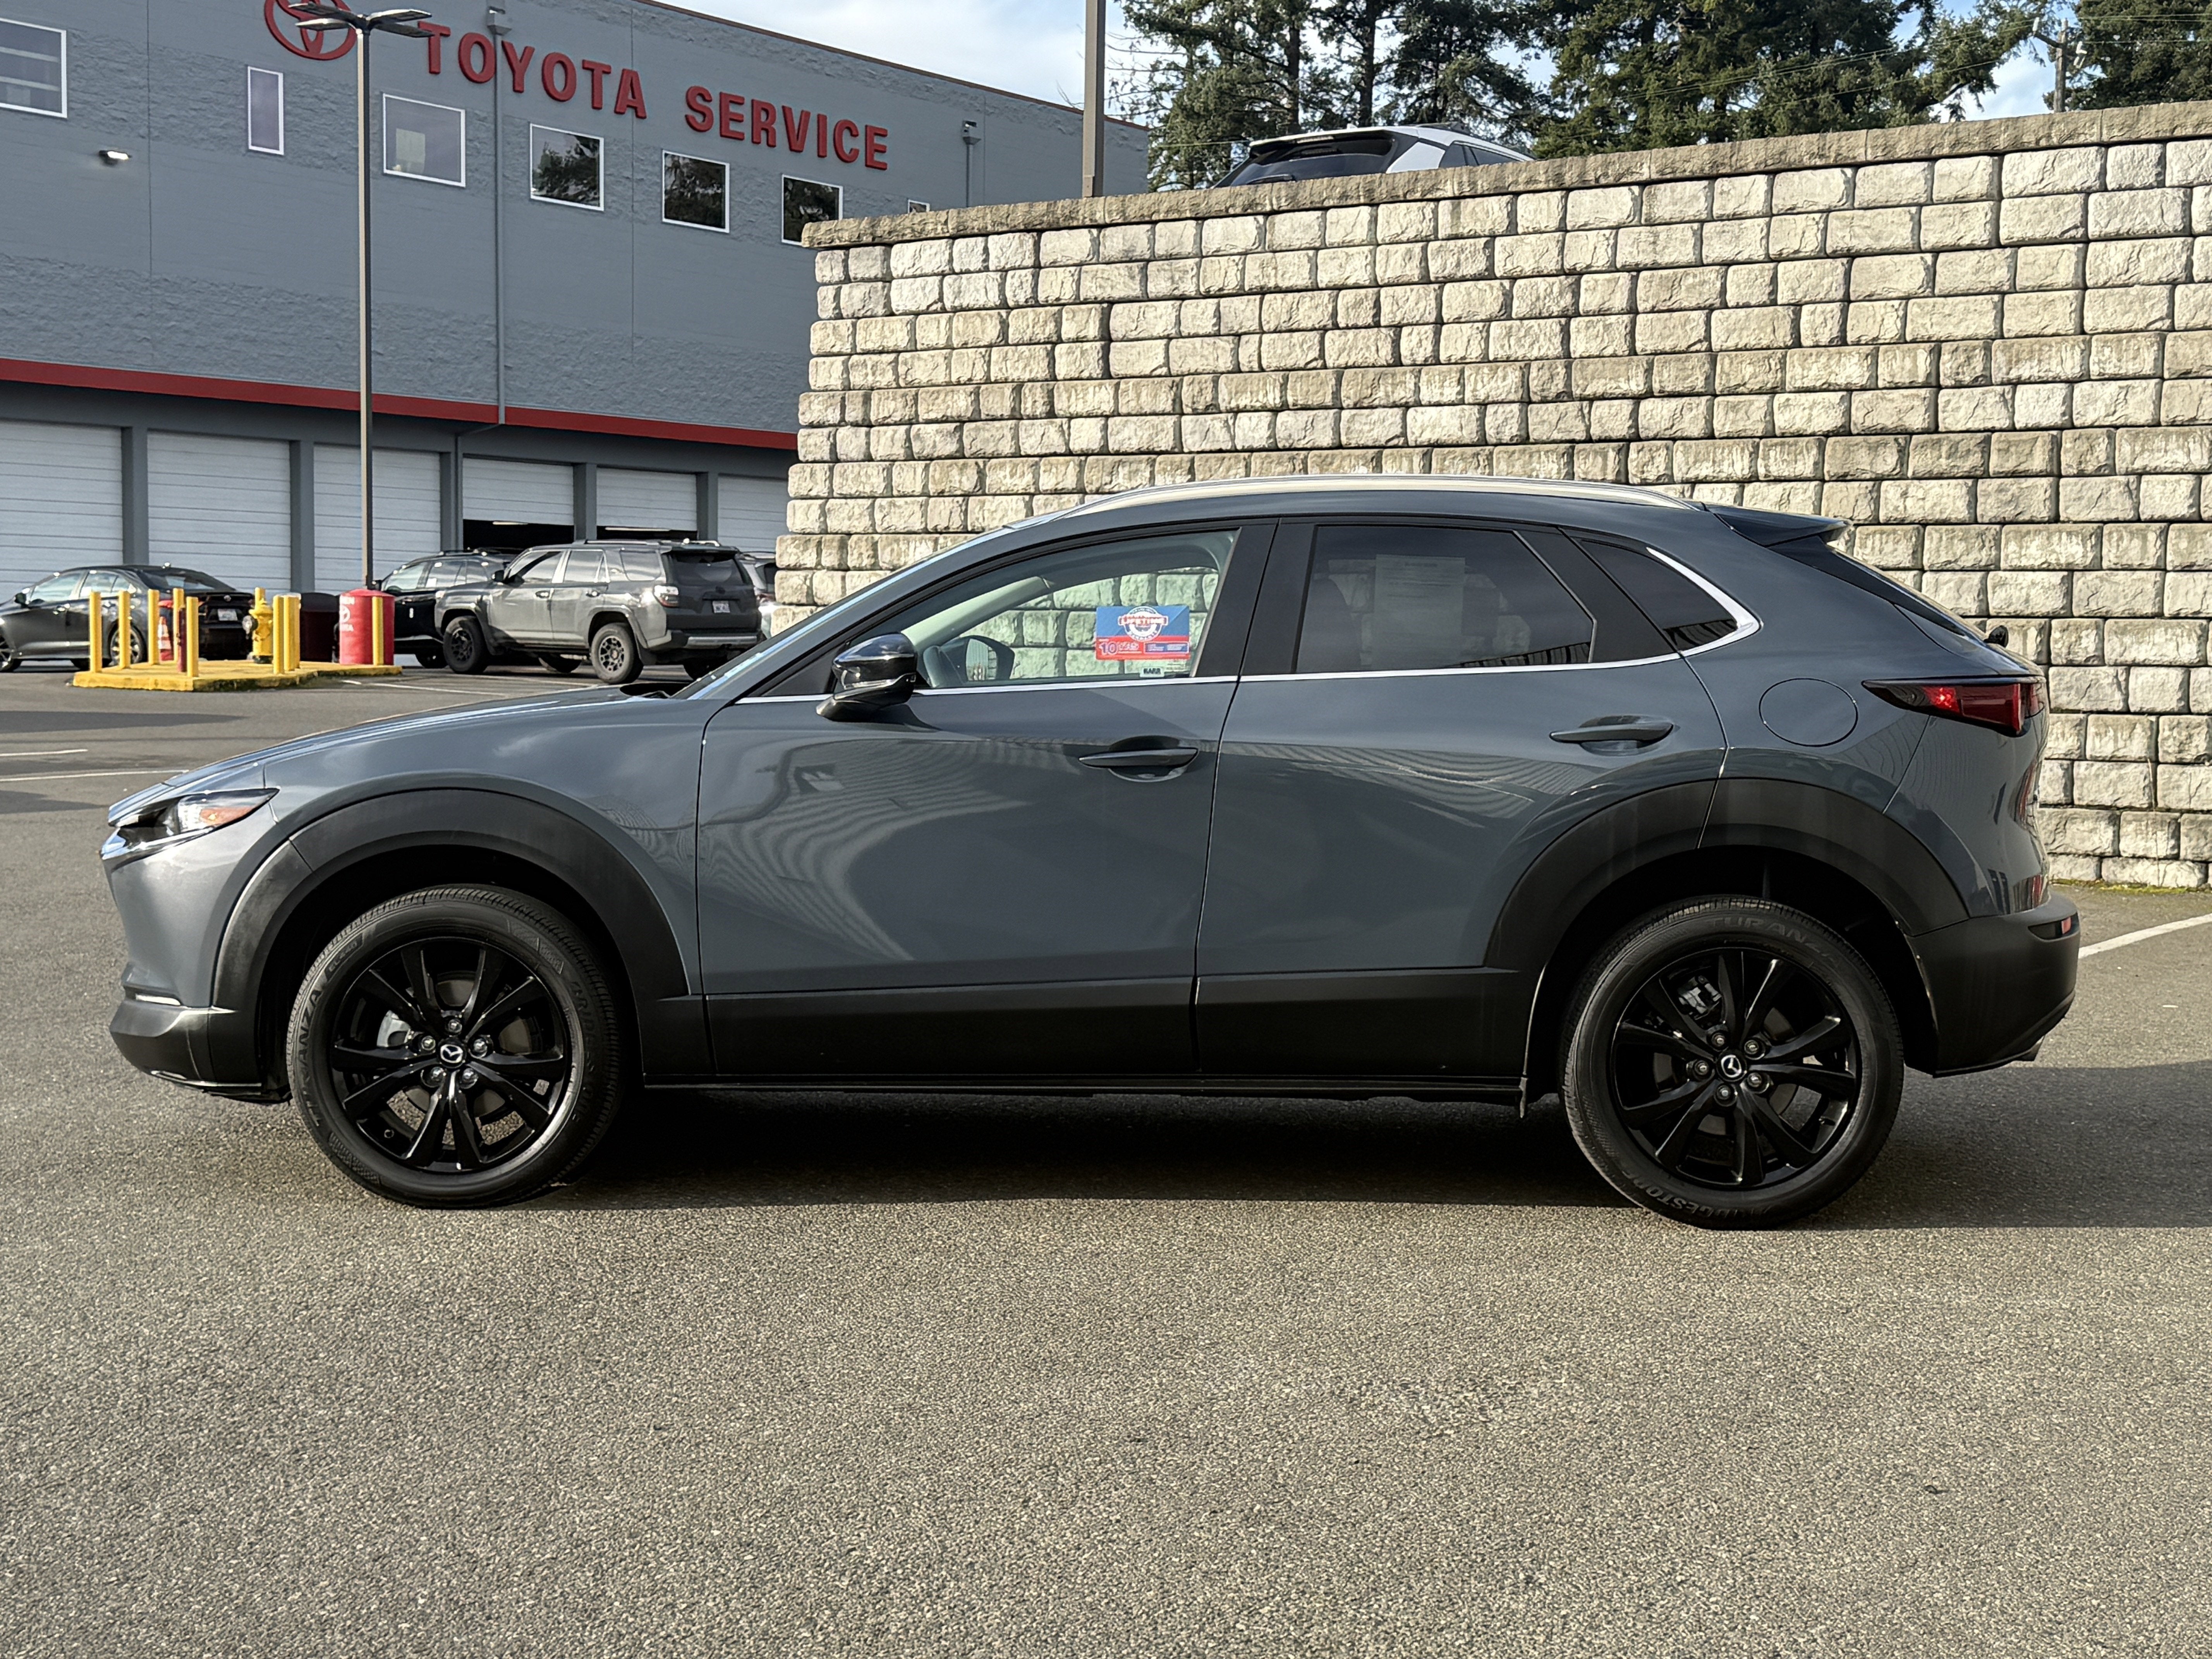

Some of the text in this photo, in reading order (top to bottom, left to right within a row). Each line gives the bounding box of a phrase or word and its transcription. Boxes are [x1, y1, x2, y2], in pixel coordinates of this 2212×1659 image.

[417, 21, 889, 171] TOYOTA SERVICE
[1099, 641, 1117, 655] 10
[298, 988, 325, 1127] TURANZA
[1621, 1170, 1774, 1218] IDGESTONE
